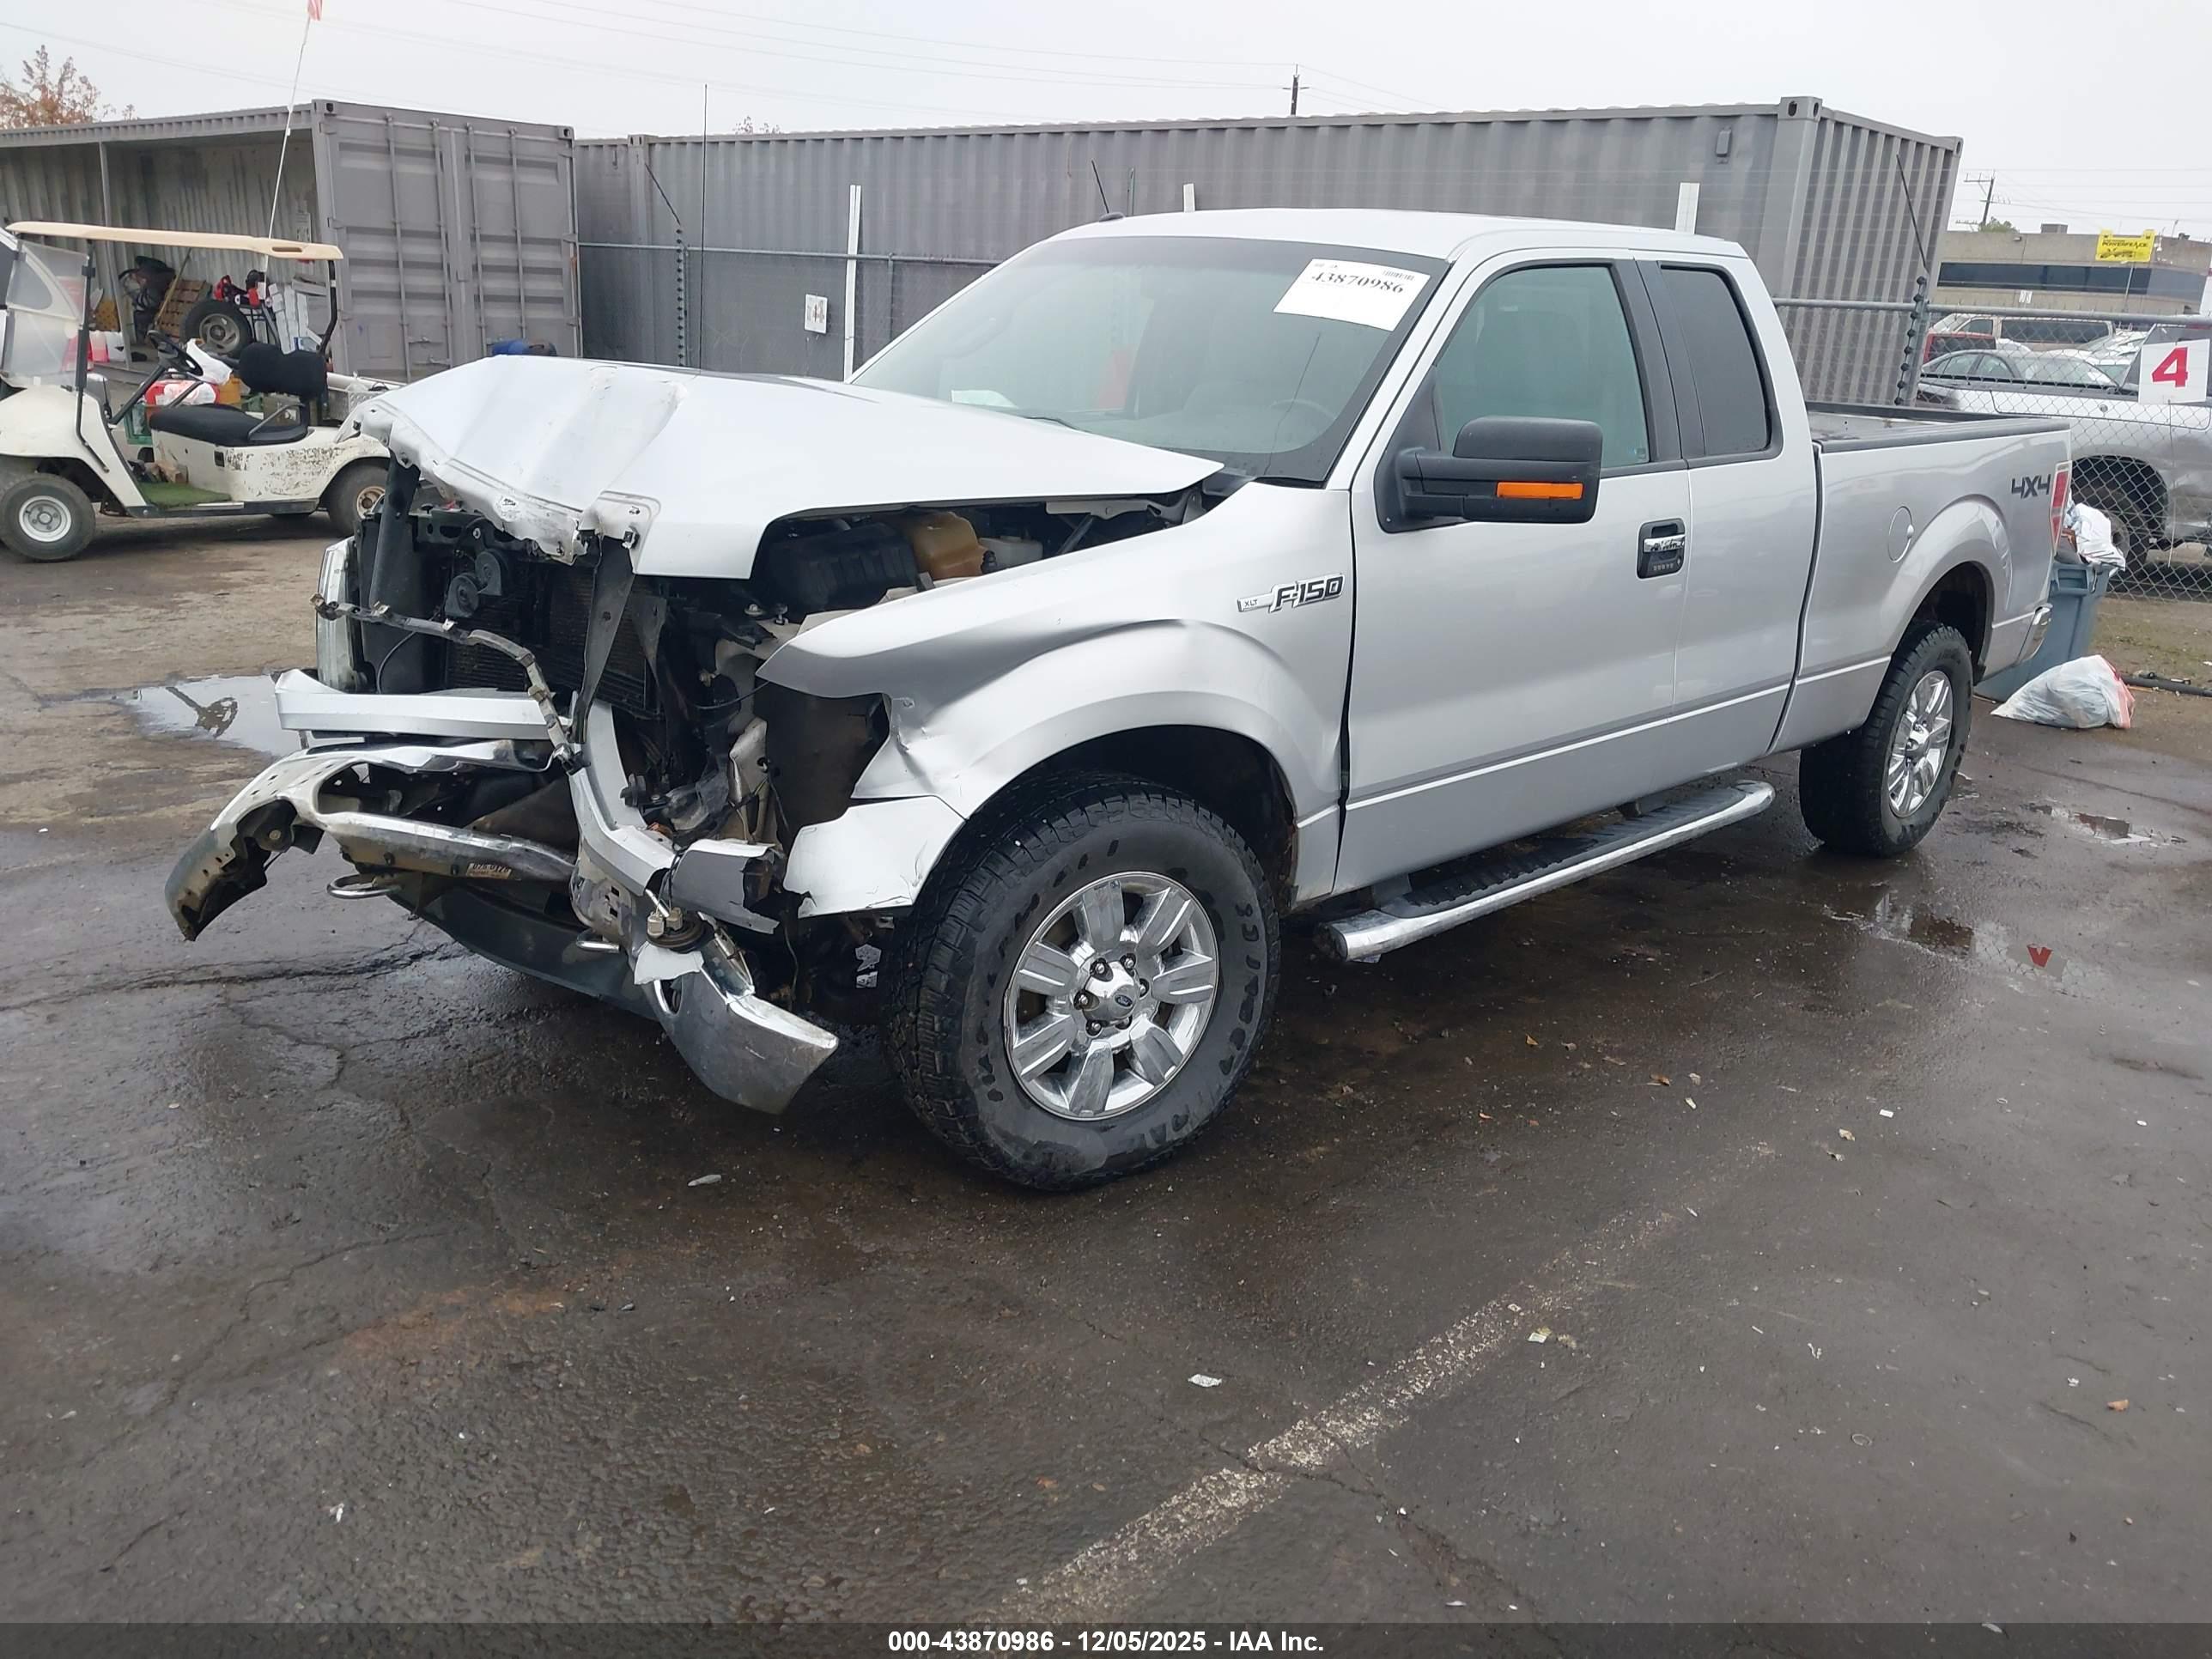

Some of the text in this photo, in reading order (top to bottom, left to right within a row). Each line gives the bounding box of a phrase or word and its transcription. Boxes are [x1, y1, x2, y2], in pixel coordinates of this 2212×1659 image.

[1312, 272, 1404, 293] 43870986
[2151, 345, 2190, 388] 4
[1243, 599, 1259, 608] XLT
